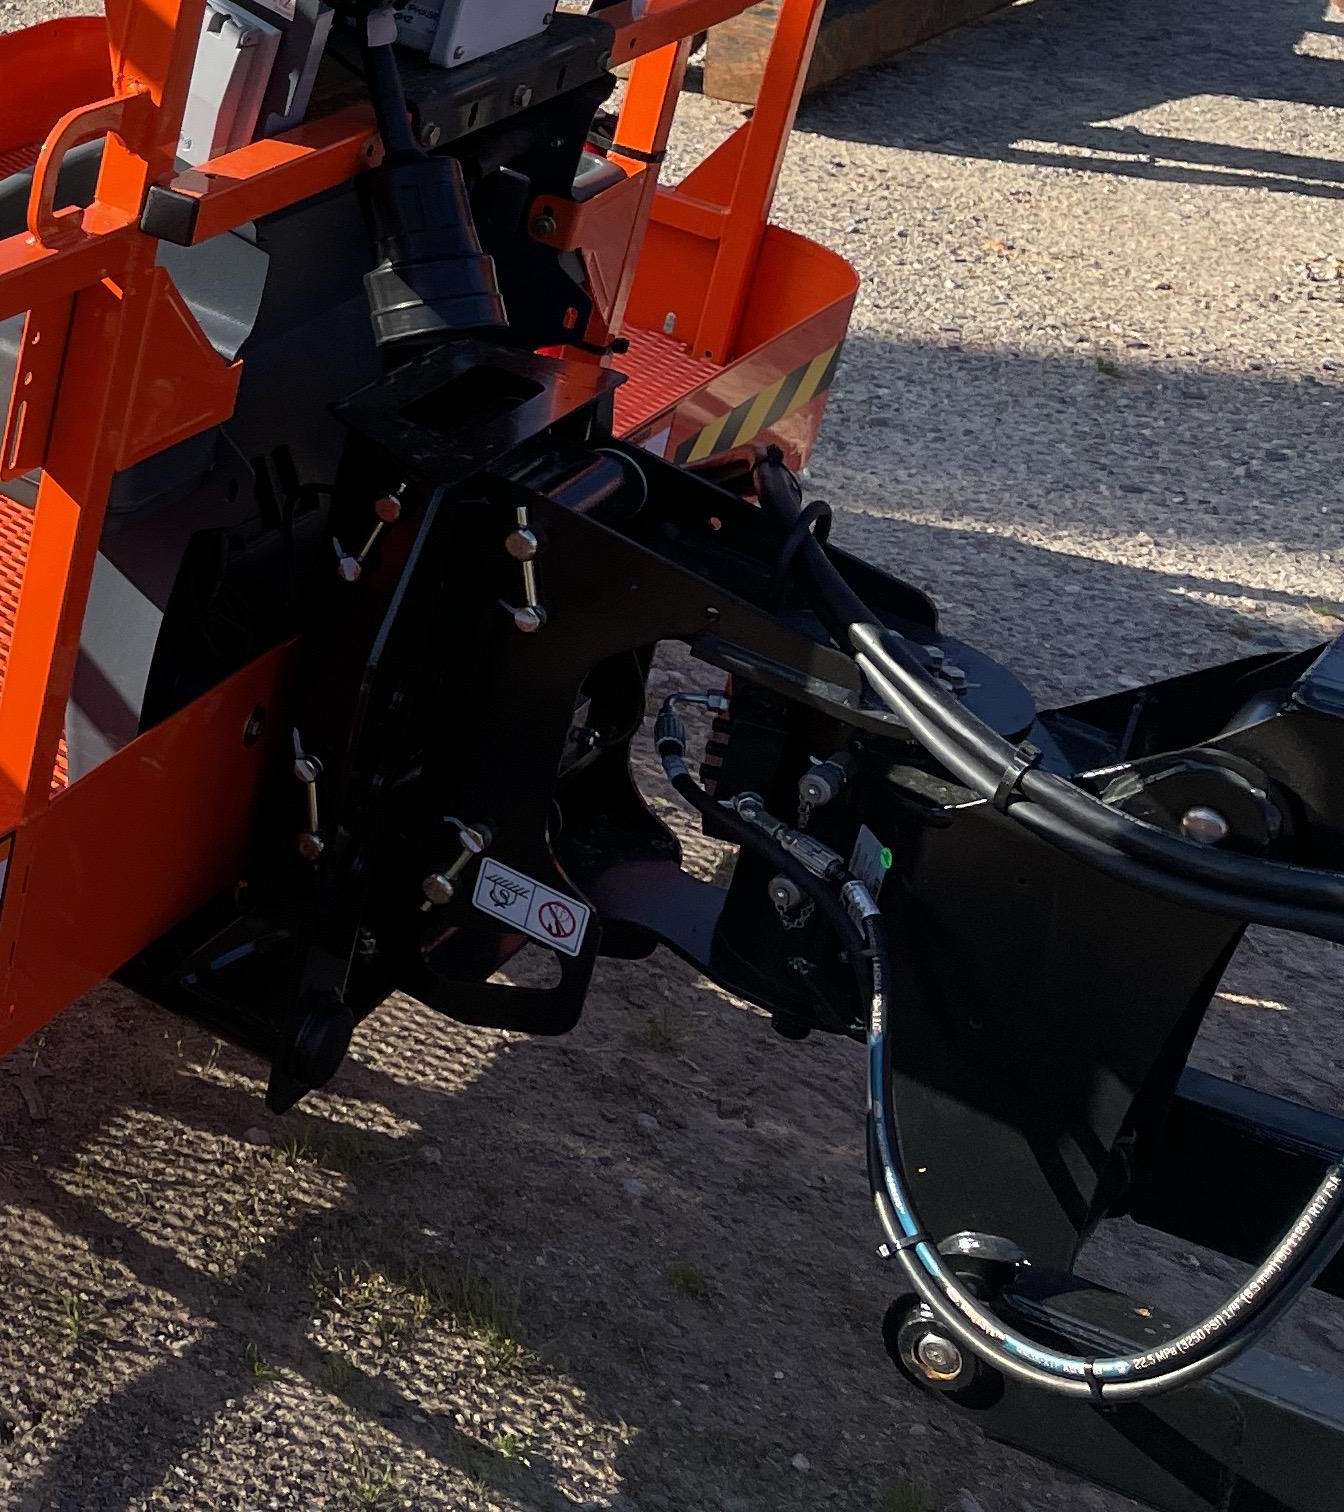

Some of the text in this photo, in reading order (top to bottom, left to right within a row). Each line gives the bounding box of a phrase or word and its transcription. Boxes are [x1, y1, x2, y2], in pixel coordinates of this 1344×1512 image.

[1132, 1355, 1157, 1370] 22.5
[1155, 1345, 1178, 1364] MPa
[1176, 1327, 1206, 1355] (3250
[1204, 1313, 1228, 1336] PSI)
